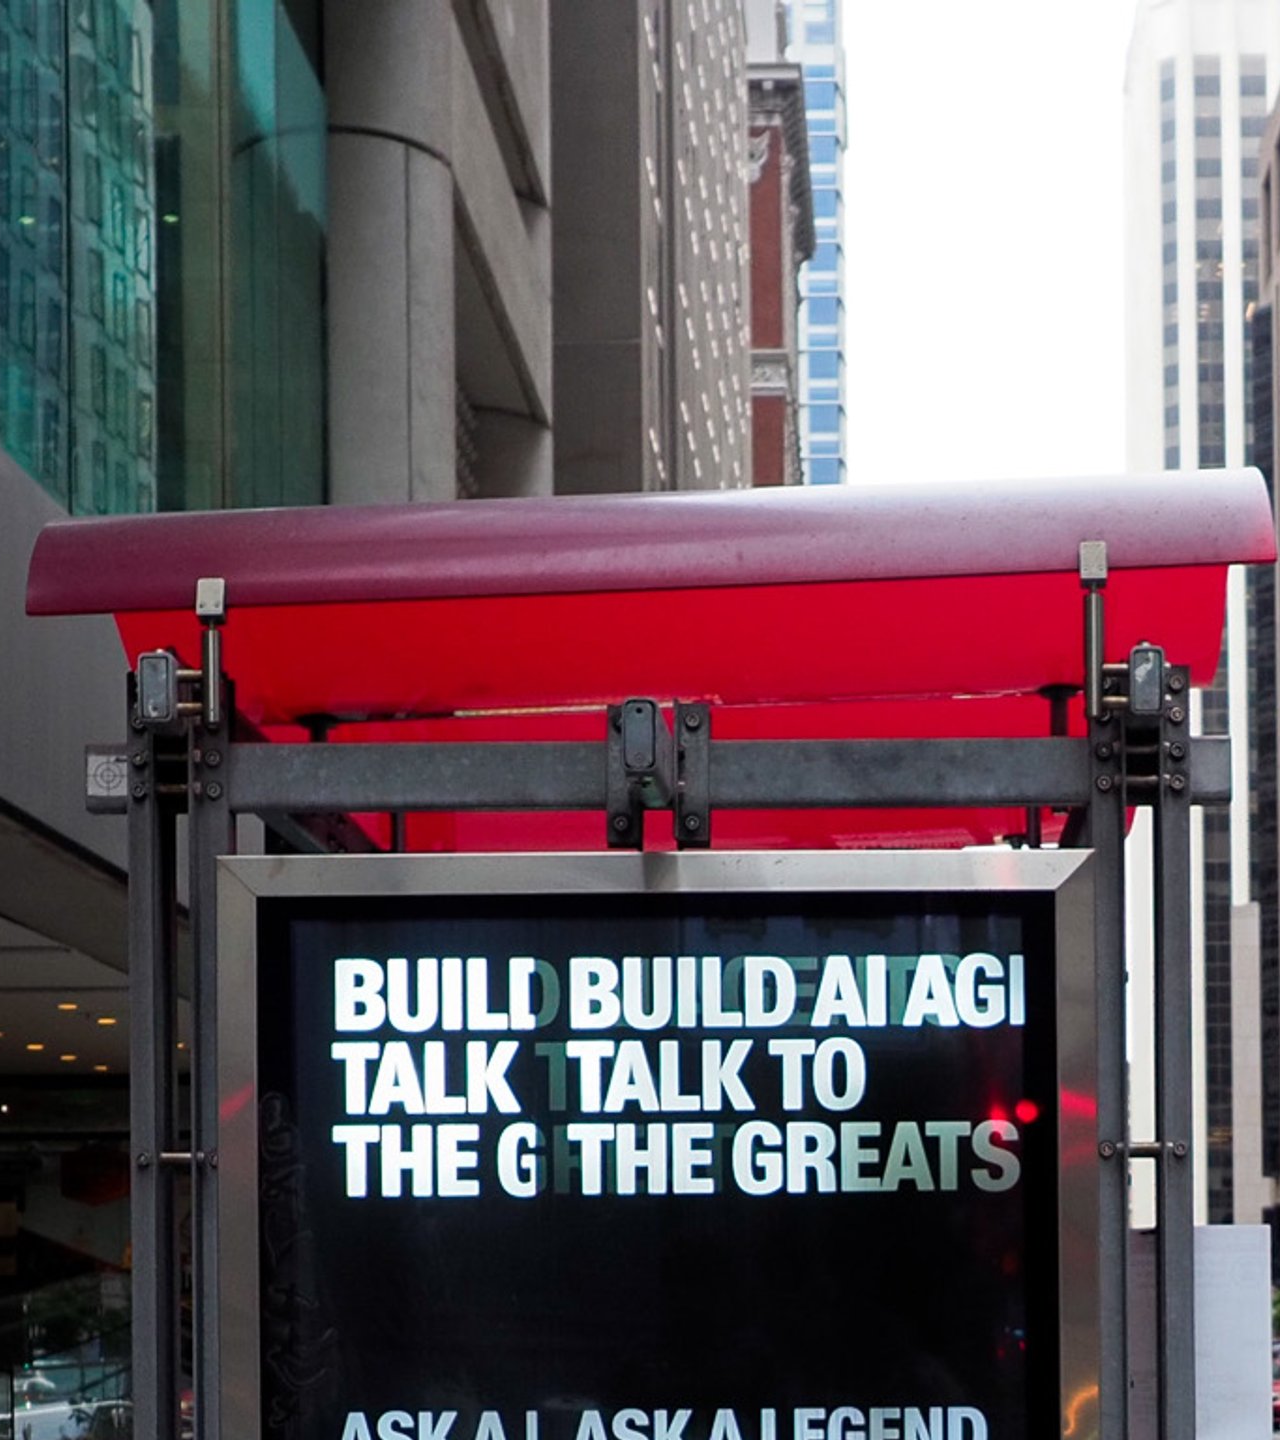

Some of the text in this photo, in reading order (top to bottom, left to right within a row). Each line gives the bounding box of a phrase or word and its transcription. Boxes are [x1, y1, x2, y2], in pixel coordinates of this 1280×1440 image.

[570, 955, 795, 1030] BUILD
[810, 954, 887, 1026] AI
[332, 1036, 866, 1115] TALK TALK TO
[332, 1124, 480, 1198] THE
[567, 1122, 715, 1196] THE
[731, 1119, 1021, 1195] GREATS
